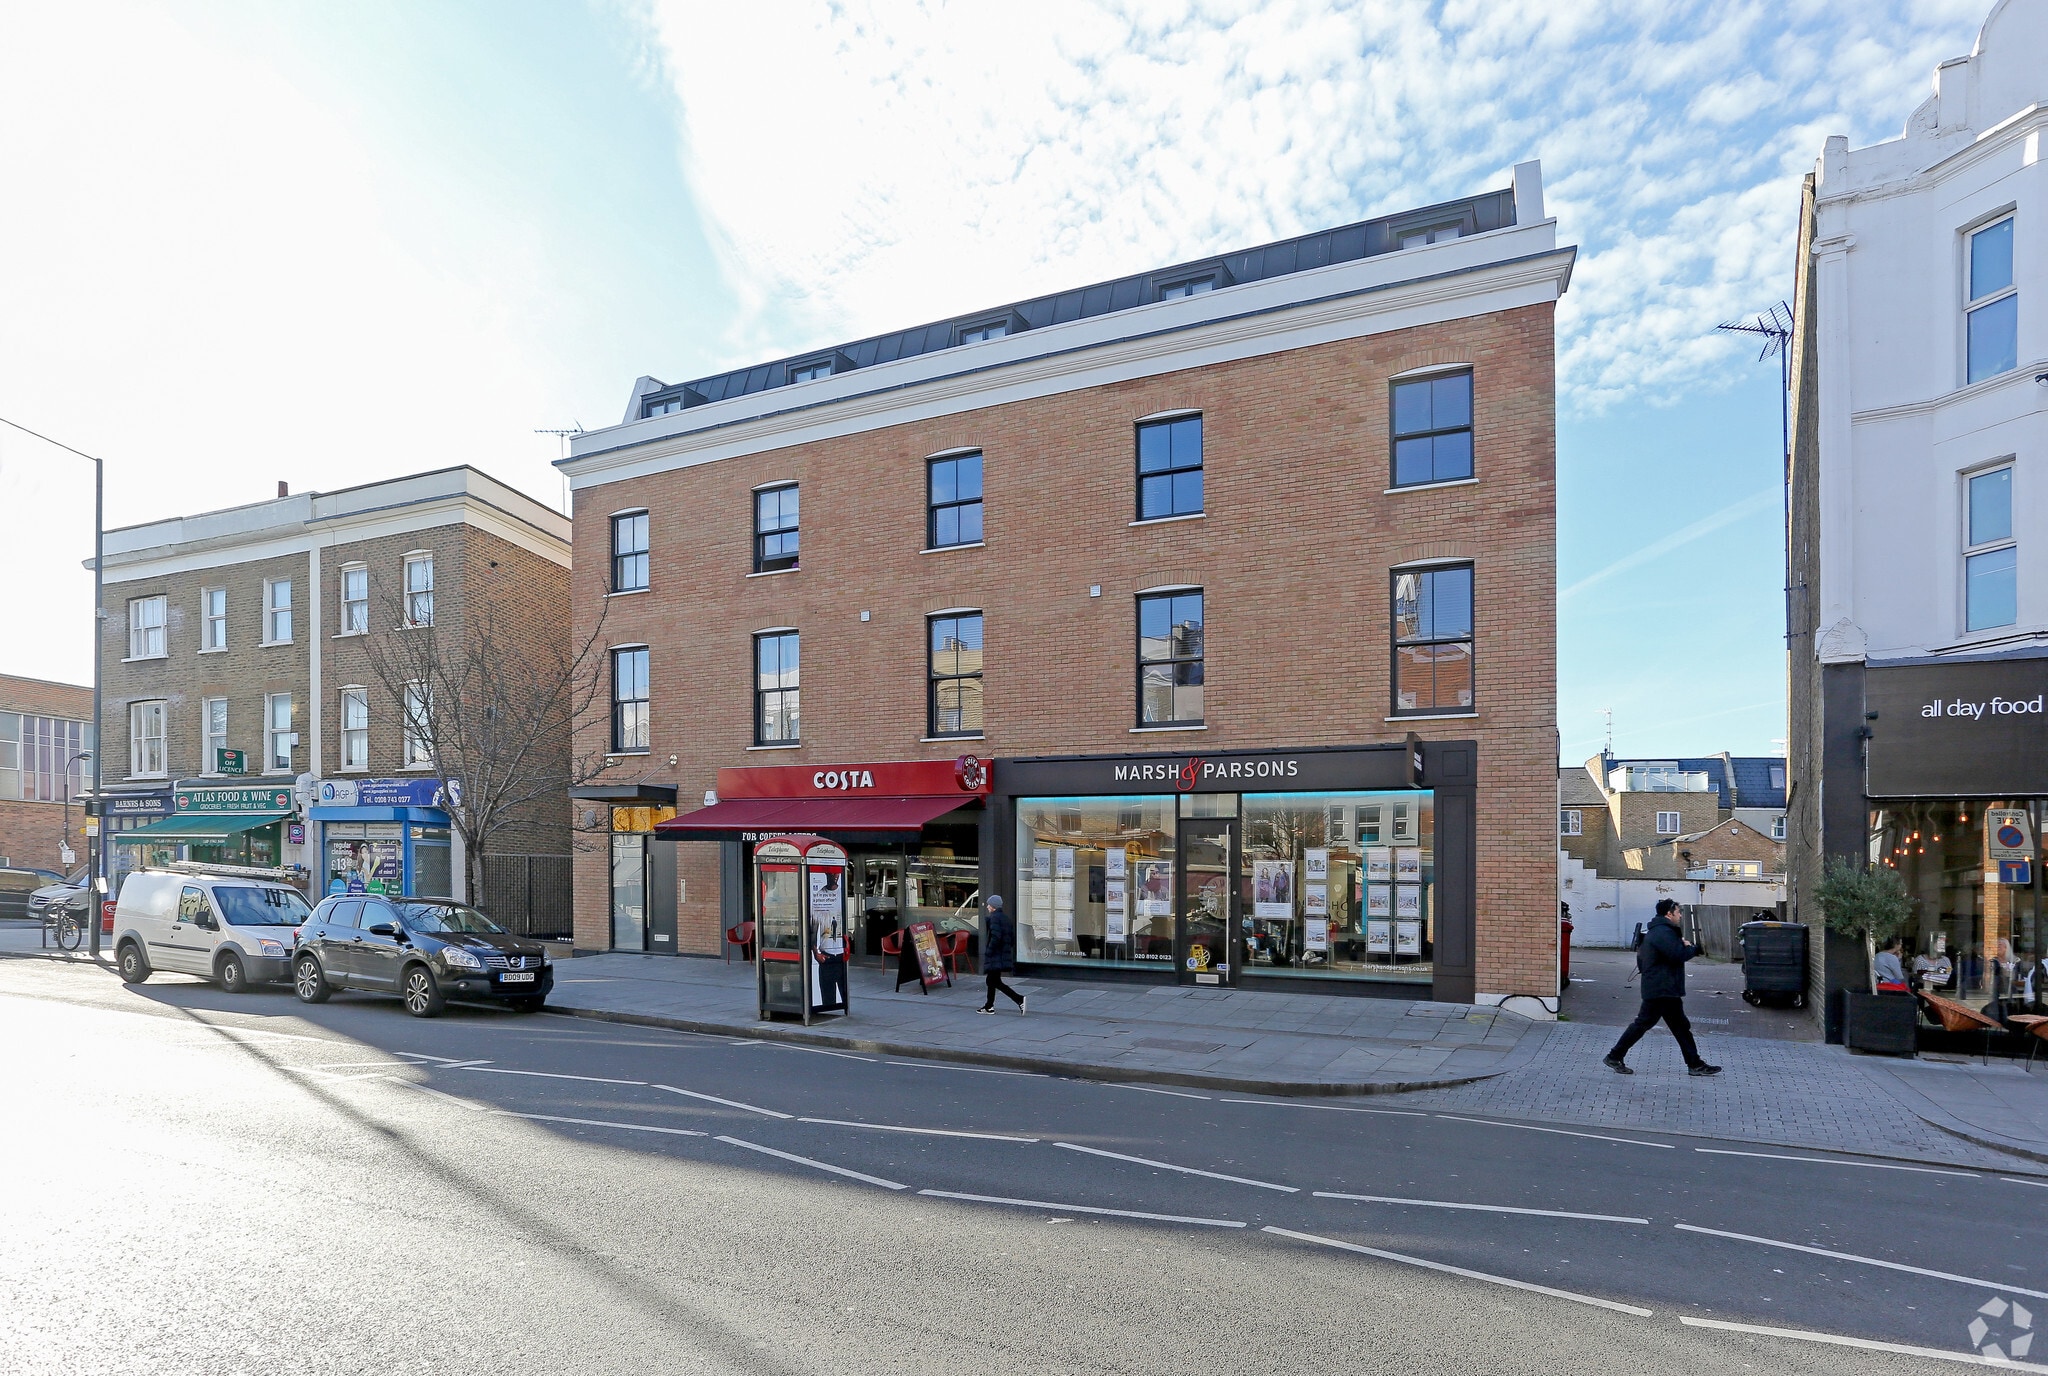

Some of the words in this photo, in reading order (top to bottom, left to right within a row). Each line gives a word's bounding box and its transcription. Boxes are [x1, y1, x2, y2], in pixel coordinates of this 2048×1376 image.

[1921, 699, 1942, 718] all
[1946, 698, 1986, 721] day
[1989, 694, 2043, 715] food
[218, 766, 243, 774] LICENCE
[1114, 764, 1180, 781] MARSH
[1175, 757, 1206, 792] &
[1203, 760, 1299, 779] PARSONS
[813, 770, 875, 791] COSTA
[192, 792, 215, 802] ATLAS
[217, 791, 240, 802] FOOD
[242, 791, 248, 801] &
[251, 791, 272, 801] WINE
[335, 789, 350, 800] AGP
[742, 832, 757, 841] FOR
